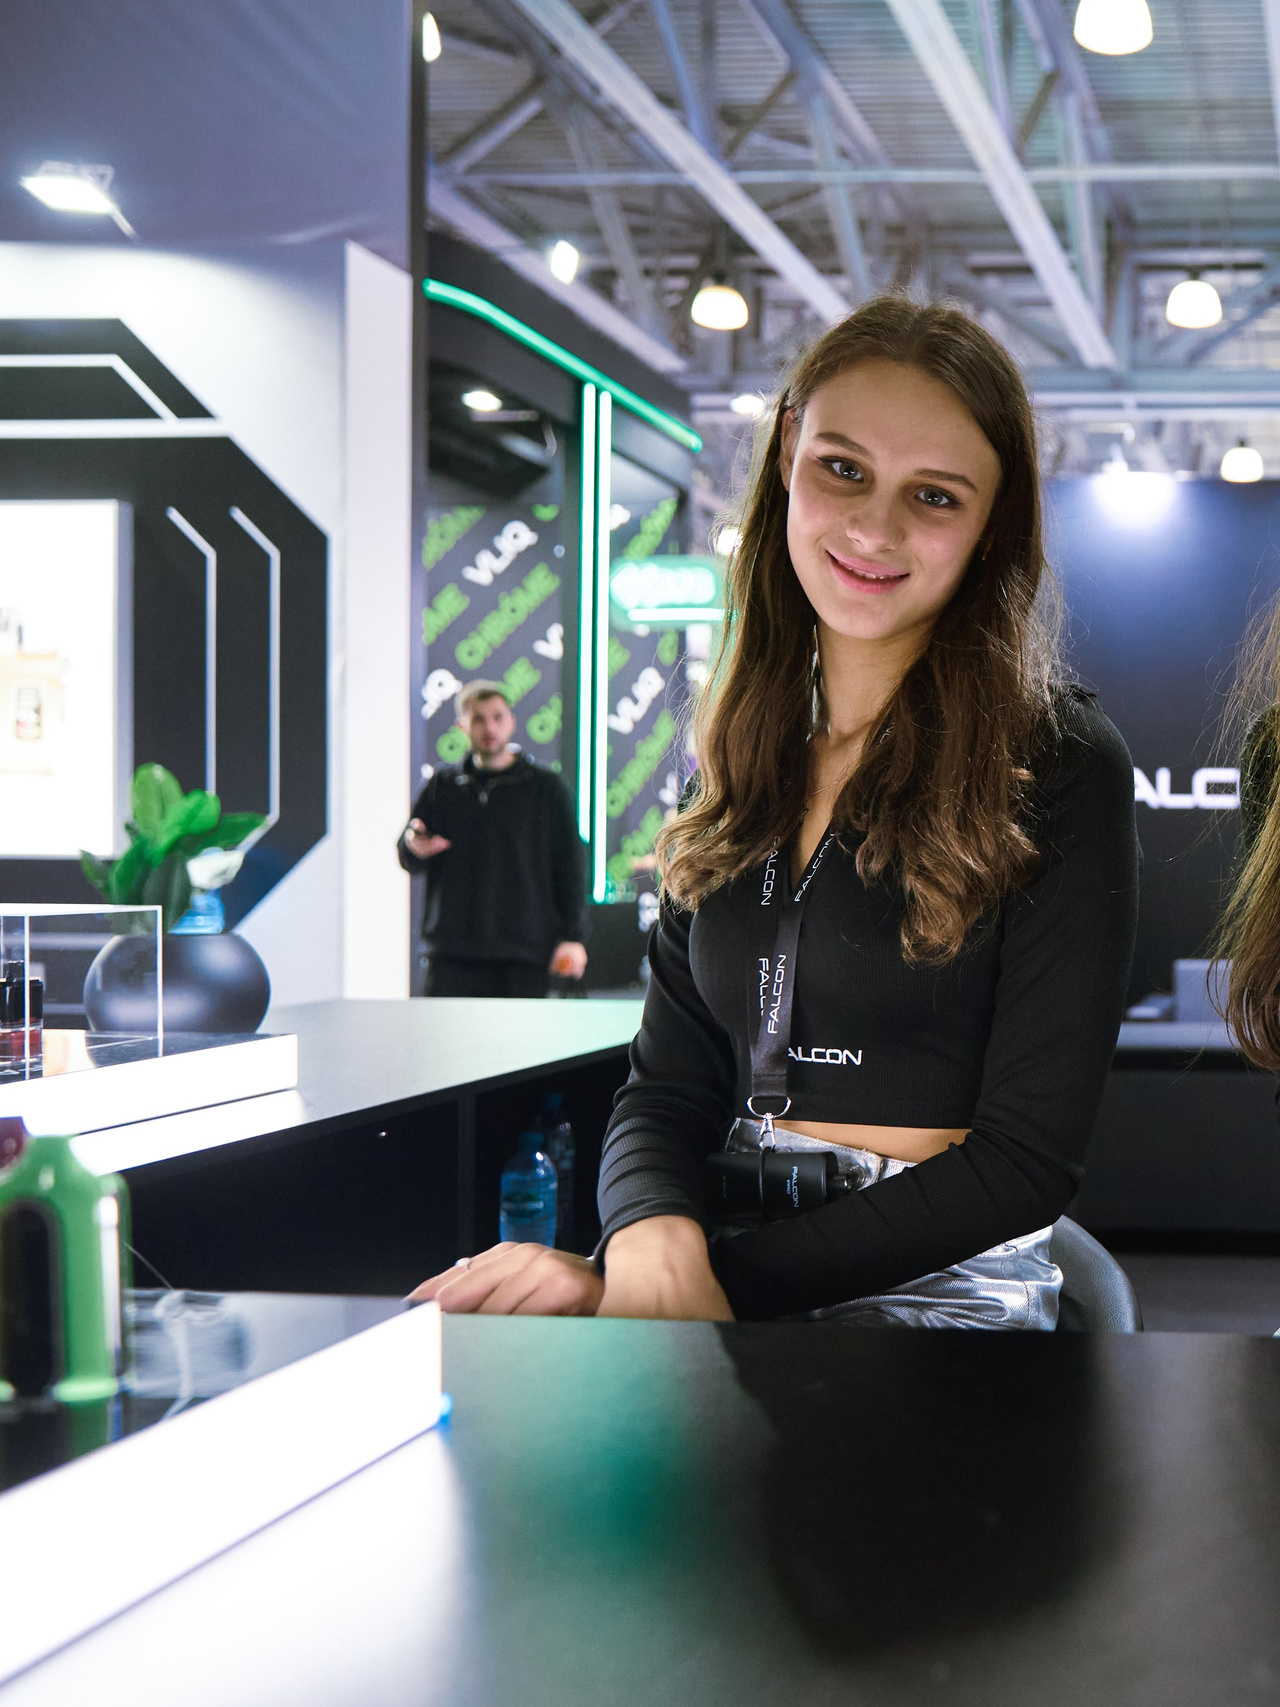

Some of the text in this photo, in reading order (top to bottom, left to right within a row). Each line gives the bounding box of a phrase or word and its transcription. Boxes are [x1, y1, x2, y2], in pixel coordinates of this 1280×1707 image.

[461, 520, 539, 586] VLIQ
[767, 954, 787, 1034] FALCON
[791, 1166, 799, 1208] FALCON
